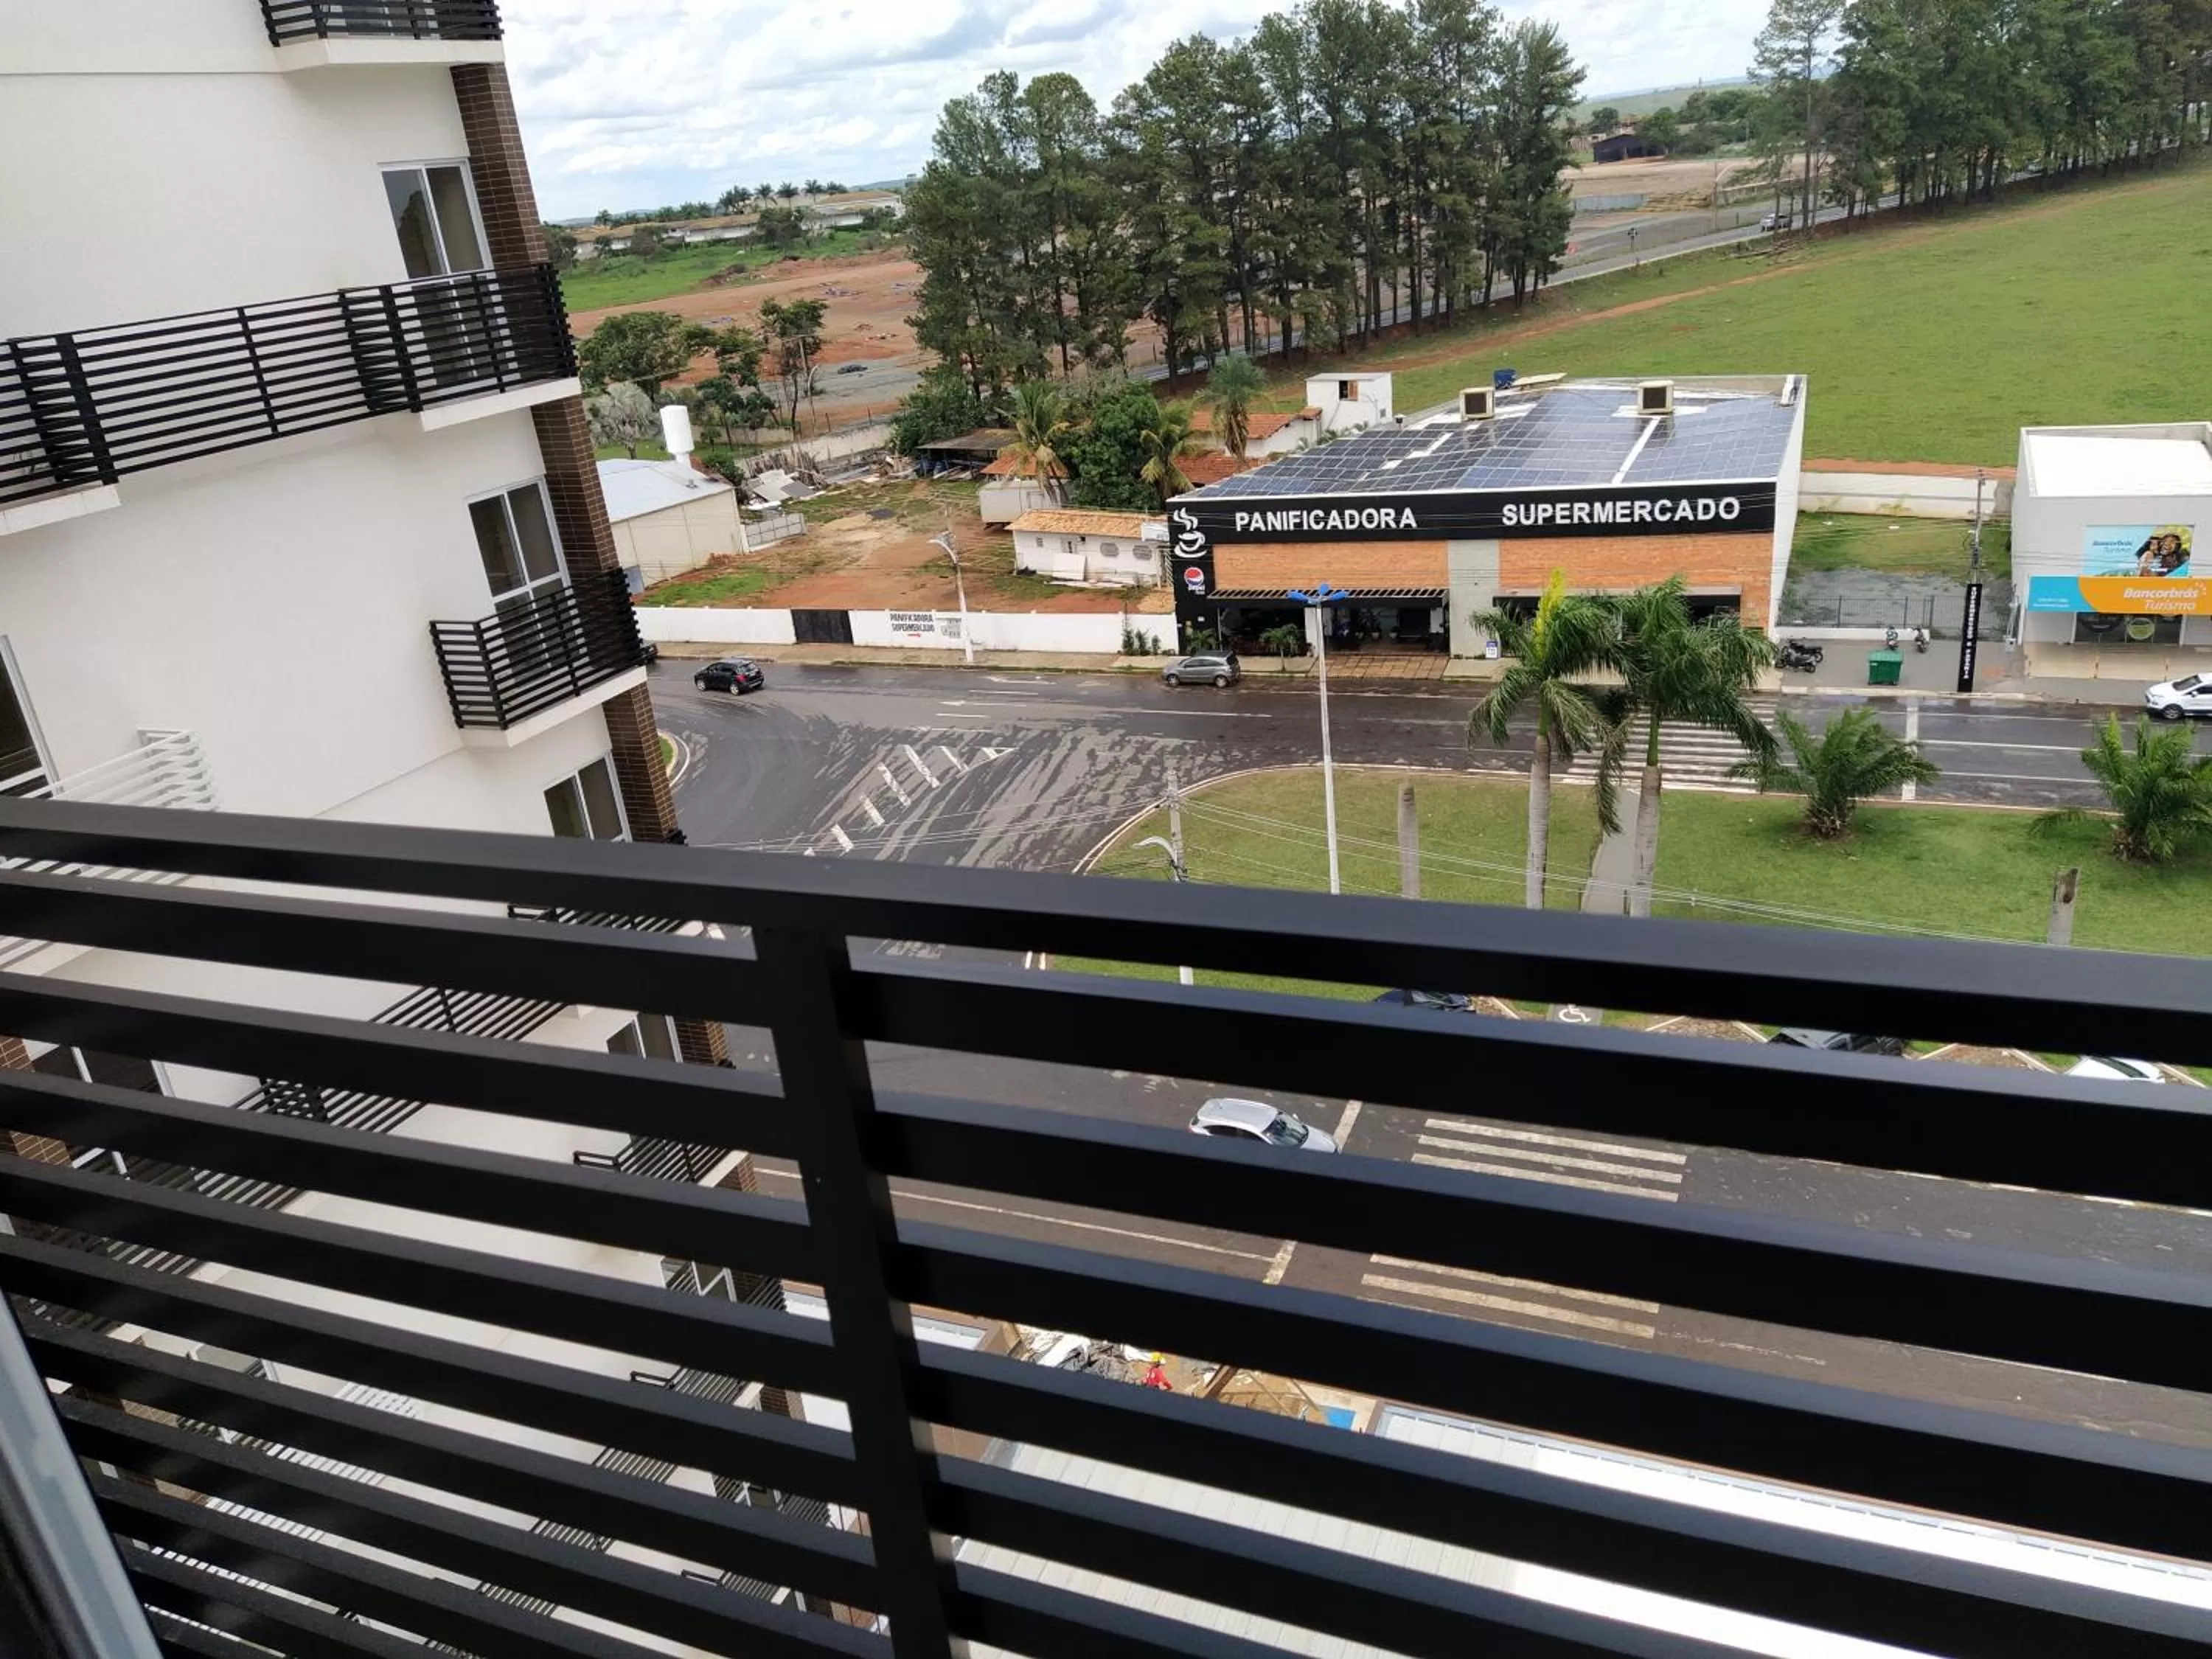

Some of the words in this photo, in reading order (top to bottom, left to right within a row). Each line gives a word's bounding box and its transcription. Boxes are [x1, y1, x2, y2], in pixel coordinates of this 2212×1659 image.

[1235, 507, 1417, 532] PANIFICADORA
[1501, 496, 1741, 526] SUPERMERCADO
[2144, 599, 2195, 611] Turismo
